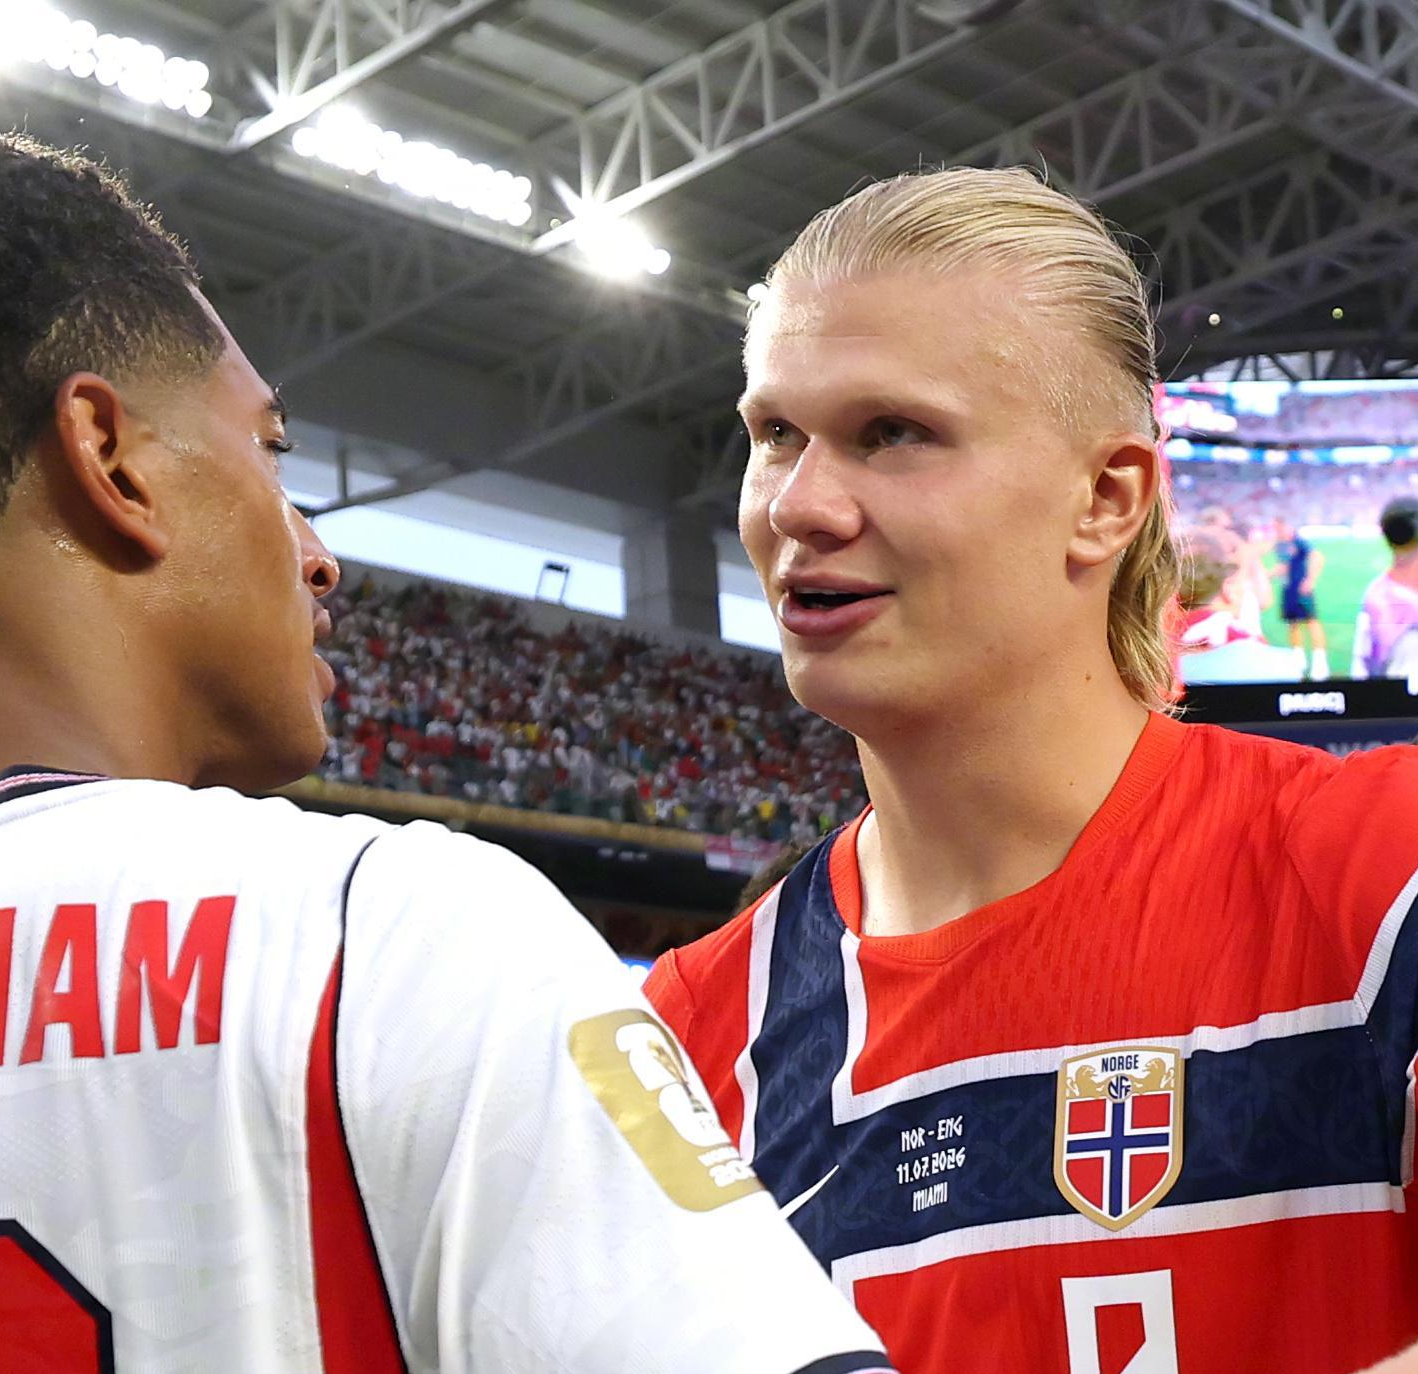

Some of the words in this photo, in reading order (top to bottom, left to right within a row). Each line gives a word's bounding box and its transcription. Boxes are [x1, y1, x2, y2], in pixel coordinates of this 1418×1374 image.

[1101, 1054, 1139, 1073] NORGE
[901, 1127, 926, 1152] NOR
[937, 1115, 963, 1141] ENG
[896, 1146, 966, 1184] 11.07.2026
[912, 1181, 948, 1212] MIAMI
